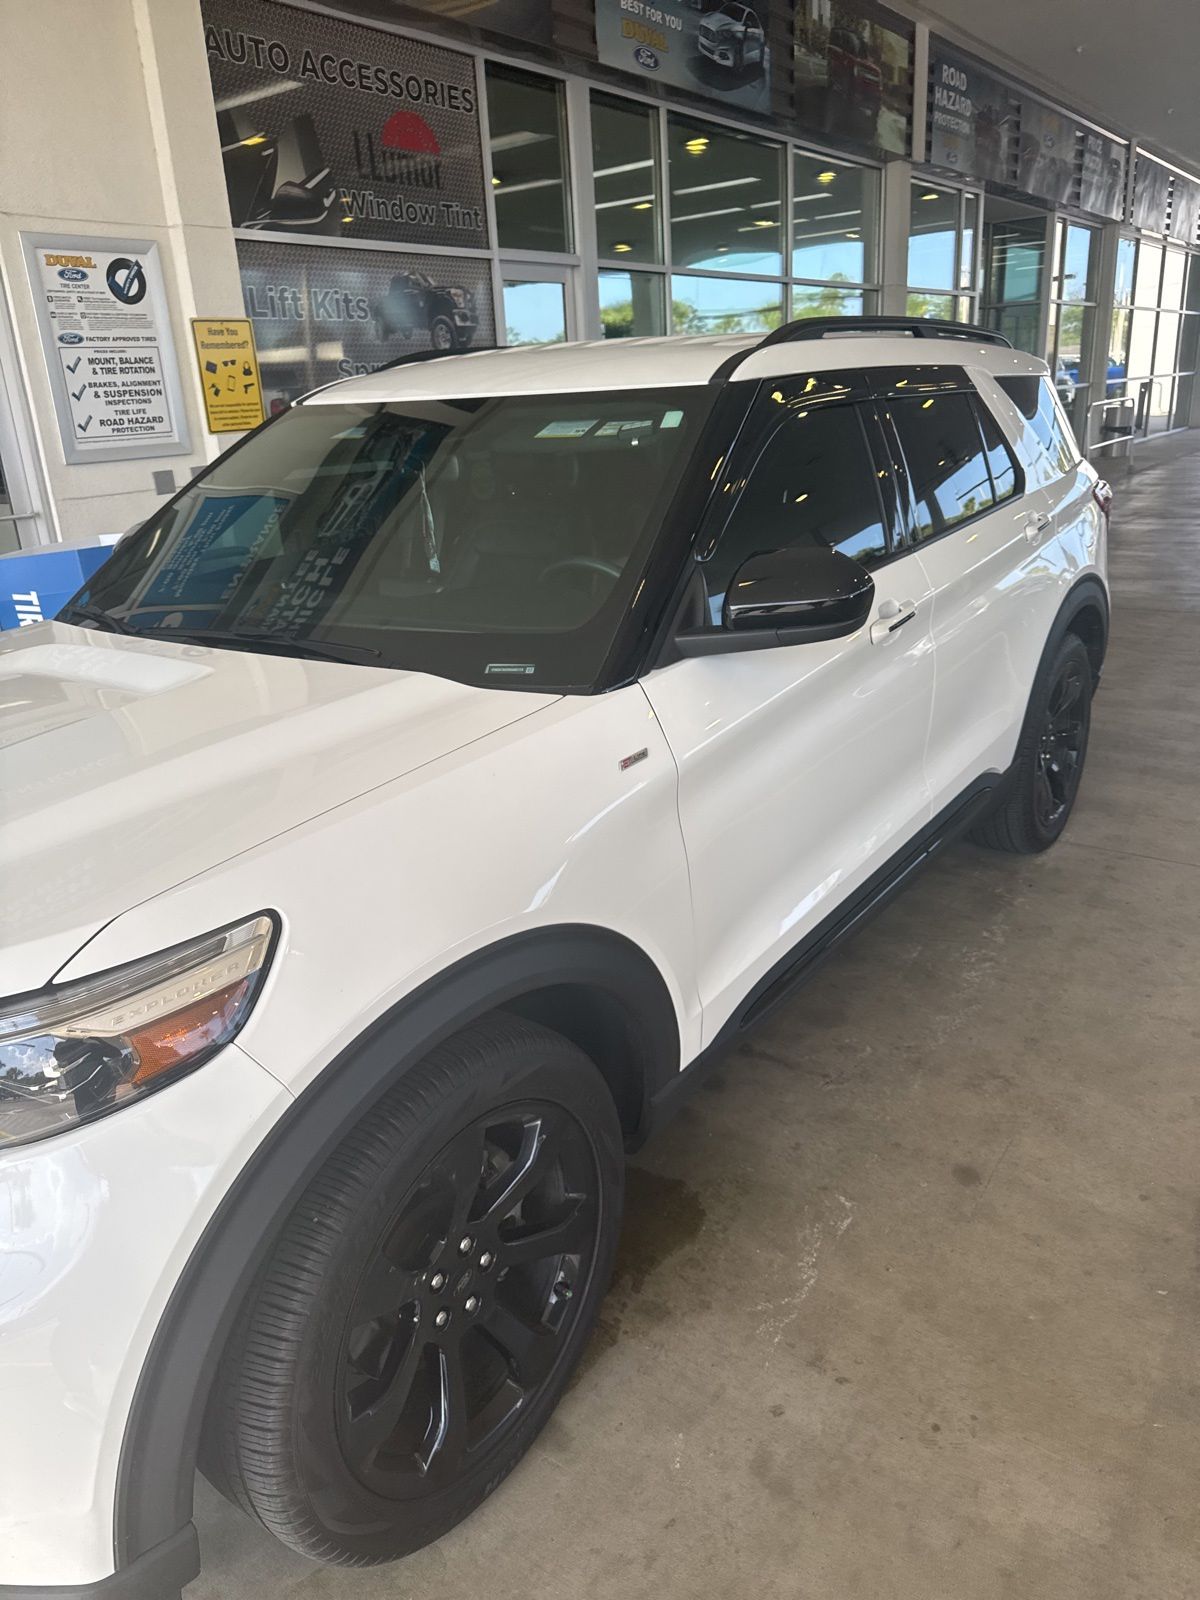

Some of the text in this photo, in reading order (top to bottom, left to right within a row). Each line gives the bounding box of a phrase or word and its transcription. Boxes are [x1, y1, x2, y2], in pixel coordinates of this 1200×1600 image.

[620, 0, 683, 31] BEST FOR YOU
[636, 47, 658, 69] Ford
[204, 24, 475, 114] AUTO ACCESSORIES
[942, 63, 968, 92] ROAD
[934, 85, 972, 117] HAZARD
[339, 188, 484, 231] Window Tint
[44, 254, 97, 269] DUVAL
[61, 268, 86, 281] Ford
[247, 285, 371, 322] Lift Kits
[207, 327, 239, 337] Have You
[87, 356, 154, 366] MOUNT, BALANCE
[92, 366, 156, 375] & TIRE ROTATION
[87, 381, 120, 389] BRAKES,
[93, 388, 163, 399] & SUSPENSION
[105, 398, 152, 406] INSPECTIONS
[99, 416, 164, 427] ROAD HAZARD
[111, 425, 155, 434] PROTECTION
[111, 961, 239, 1027] EXPLORER
